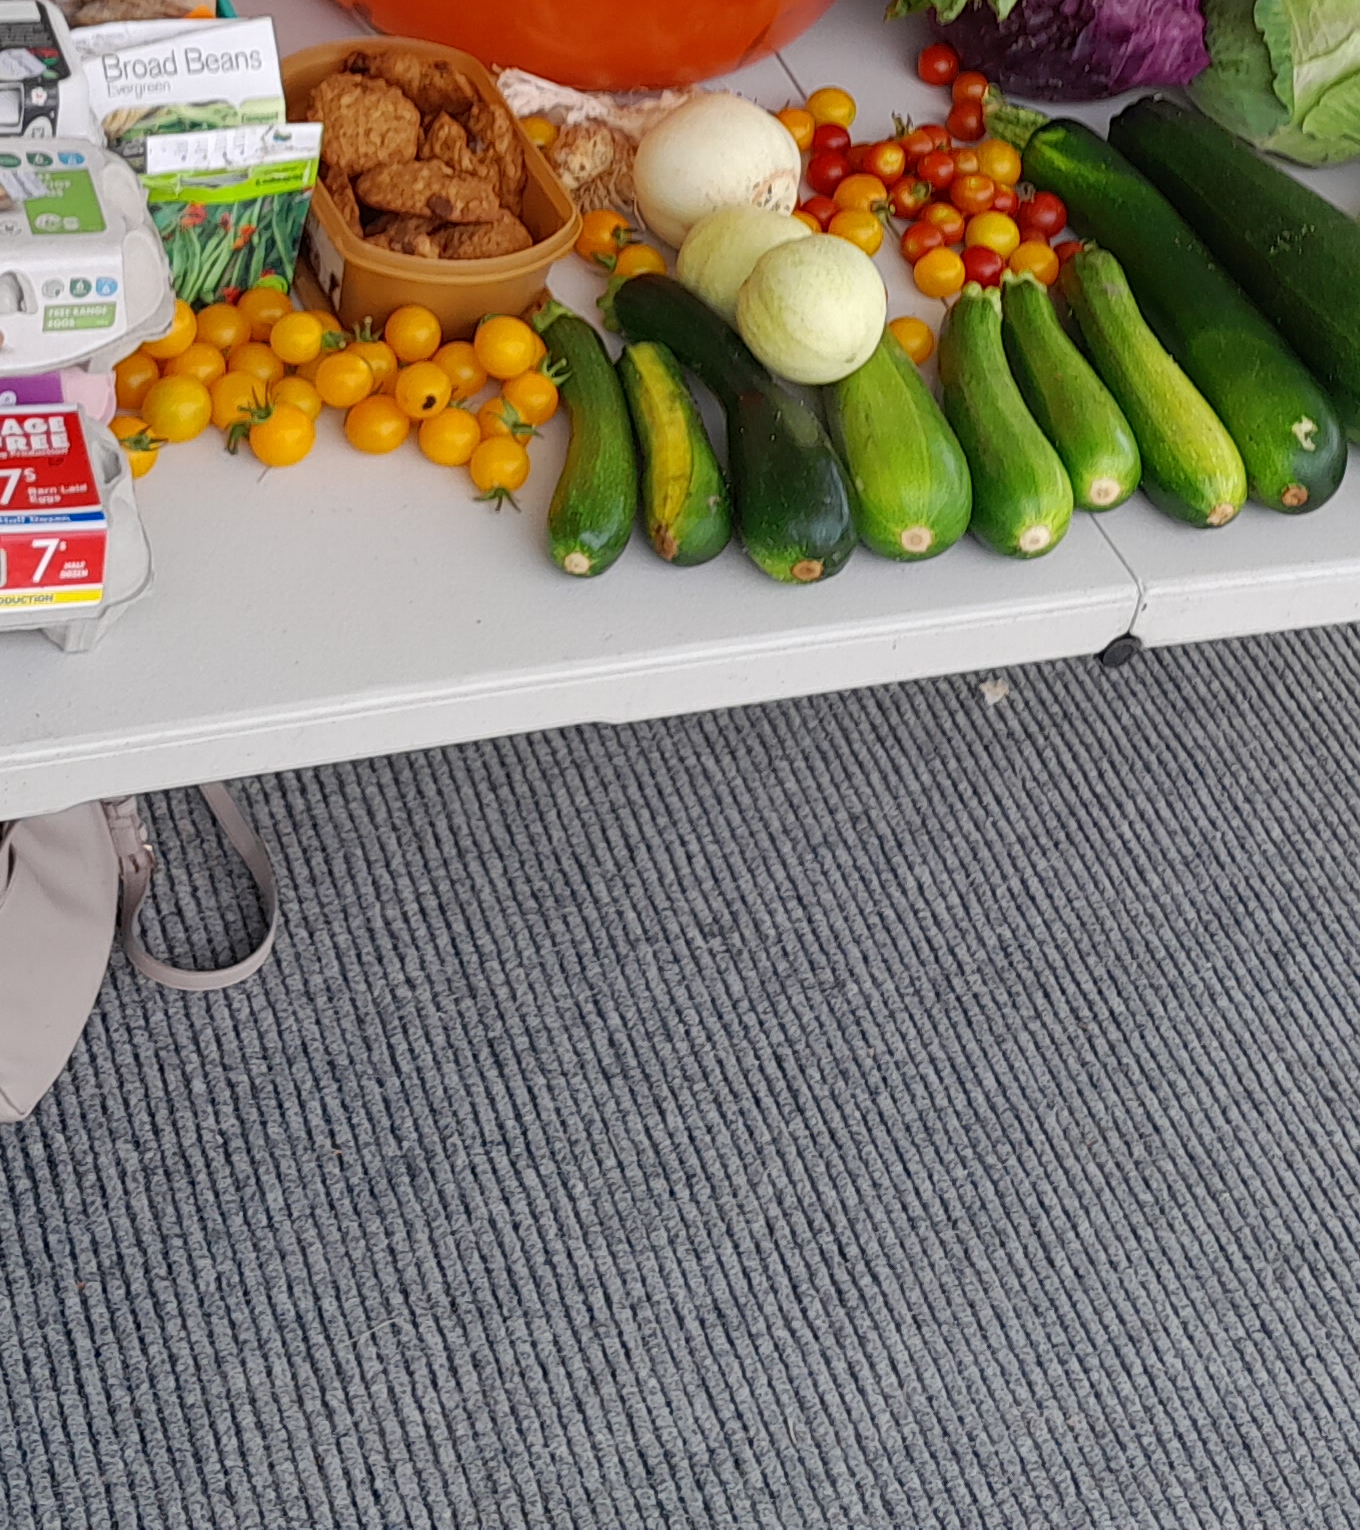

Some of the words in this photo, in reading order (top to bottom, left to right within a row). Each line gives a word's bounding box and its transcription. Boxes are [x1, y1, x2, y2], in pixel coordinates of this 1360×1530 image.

[101, 49, 178, 83] Broad
[184, 47, 263, 75] Beans
[107, 81, 171, 99] Evergreen
[48, 308, 71, 317] FREE
[73, 306, 108, 316] RANGE
[47, 318, 75, 328] EGGS
